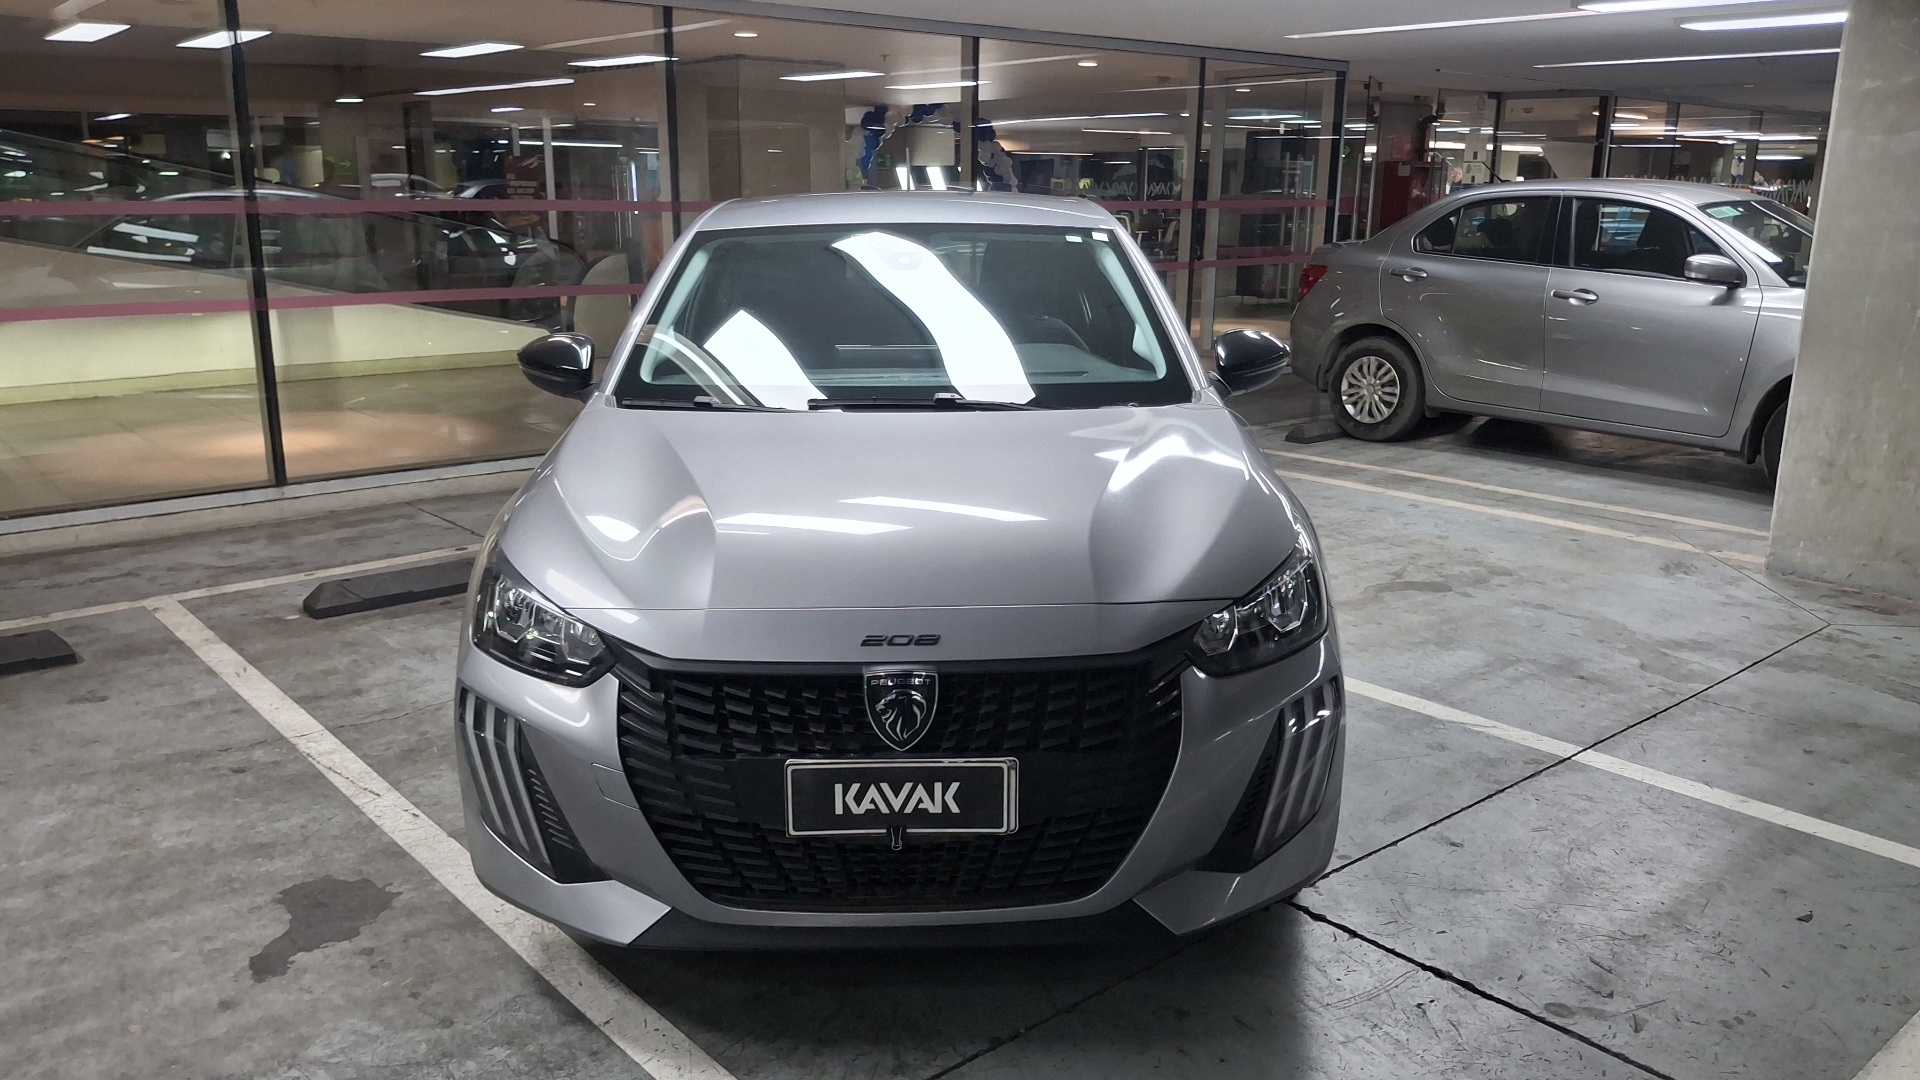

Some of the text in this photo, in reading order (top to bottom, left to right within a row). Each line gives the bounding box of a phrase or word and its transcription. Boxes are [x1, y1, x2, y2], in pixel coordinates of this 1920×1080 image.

[860, 634, 941, 647] 208
[870, 677, 932, 686] PEUGEOT
[834, 781, 961, 815] KAVAK
